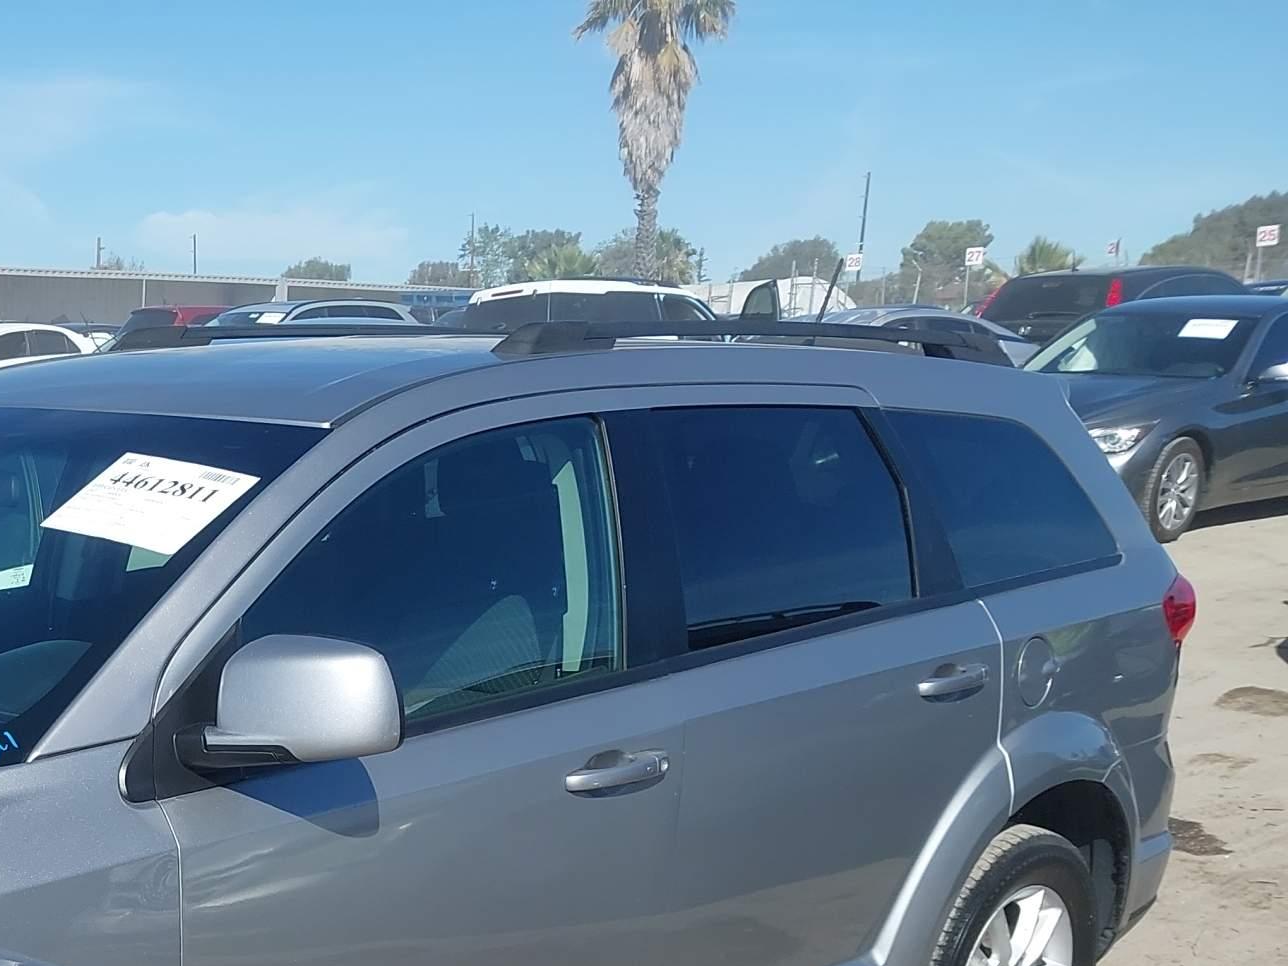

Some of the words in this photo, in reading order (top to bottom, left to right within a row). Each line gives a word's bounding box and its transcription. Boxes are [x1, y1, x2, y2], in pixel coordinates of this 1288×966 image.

[1258, 229, 1277, 242] 25
[847, 256, 861, 268] 28
[967, 250, 982, 262] 27
[109, 472, 220, 504] 44612811
